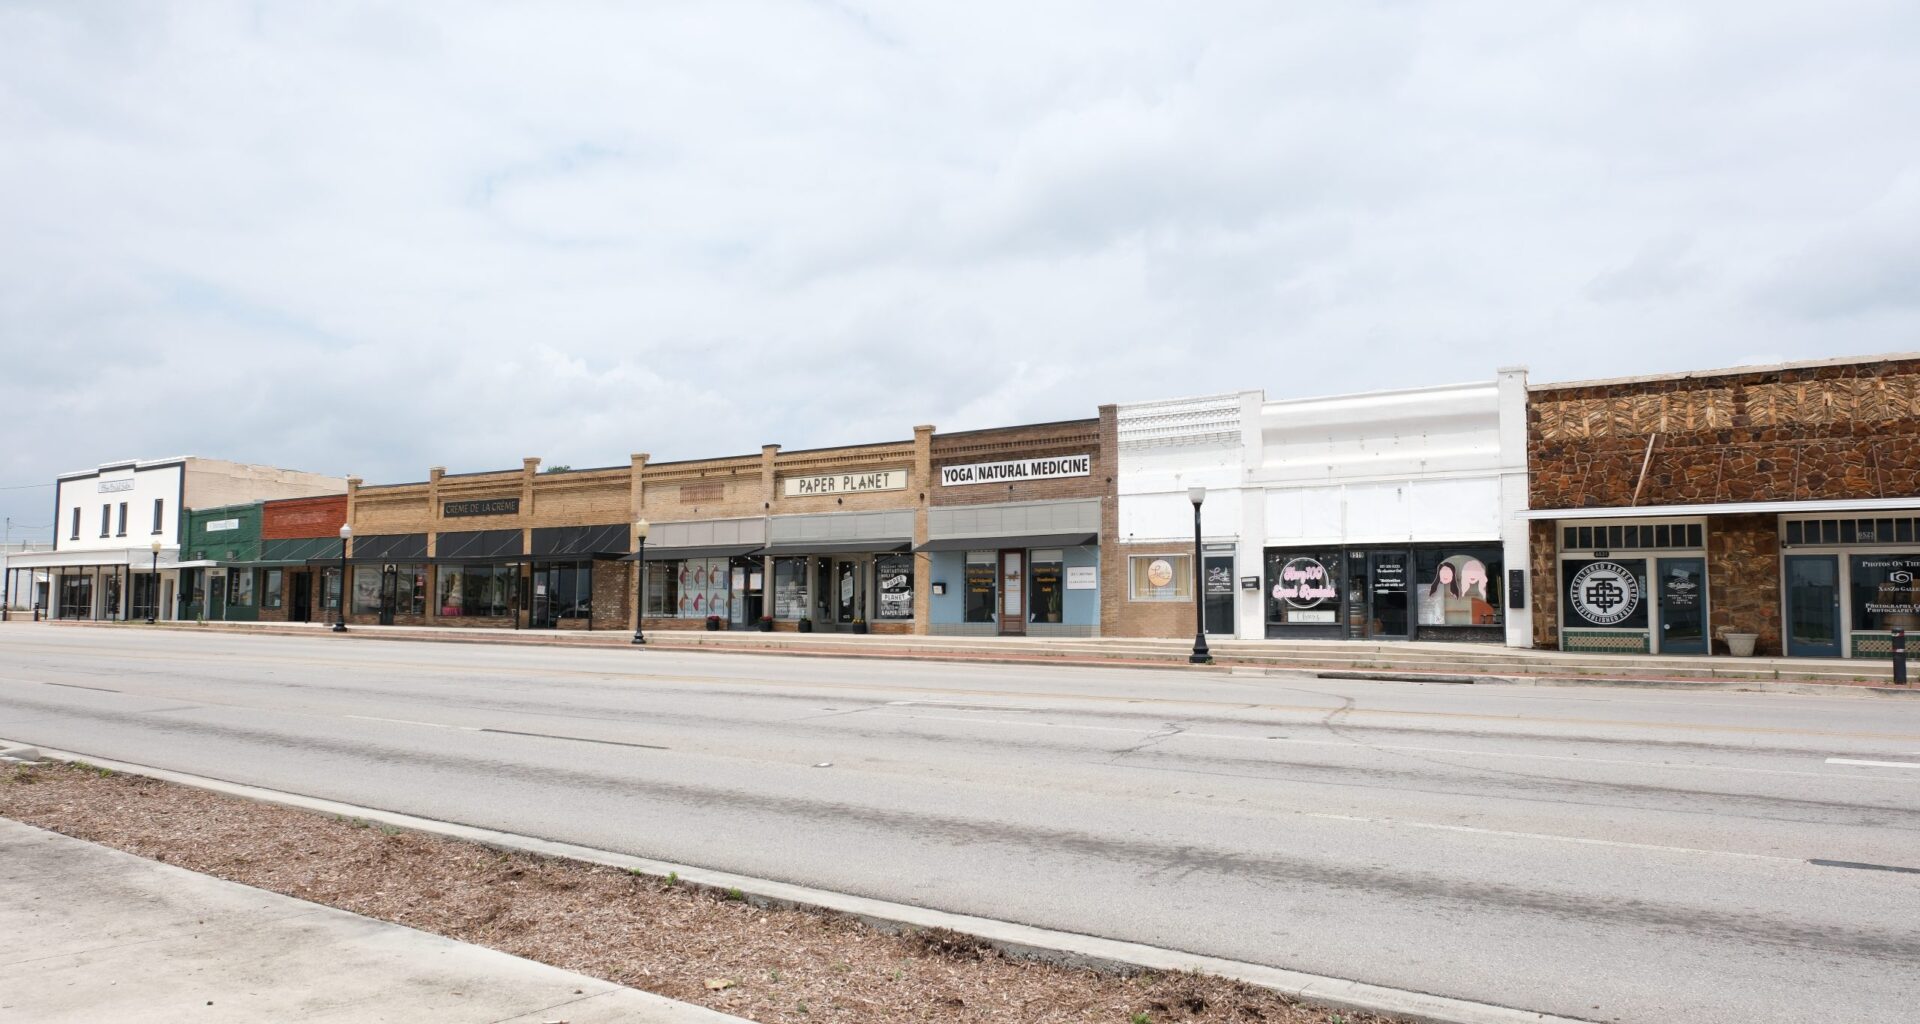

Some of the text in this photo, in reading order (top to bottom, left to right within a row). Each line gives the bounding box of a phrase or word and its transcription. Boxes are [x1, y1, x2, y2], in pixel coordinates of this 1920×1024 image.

[944, 458, 1088, 483] YOGA NATURAL MEDICINE
[799, 473, 889, 493] PAPER PLANET
[470, 503, 480, 513] DE
[483, 502, 491, 512] LA
